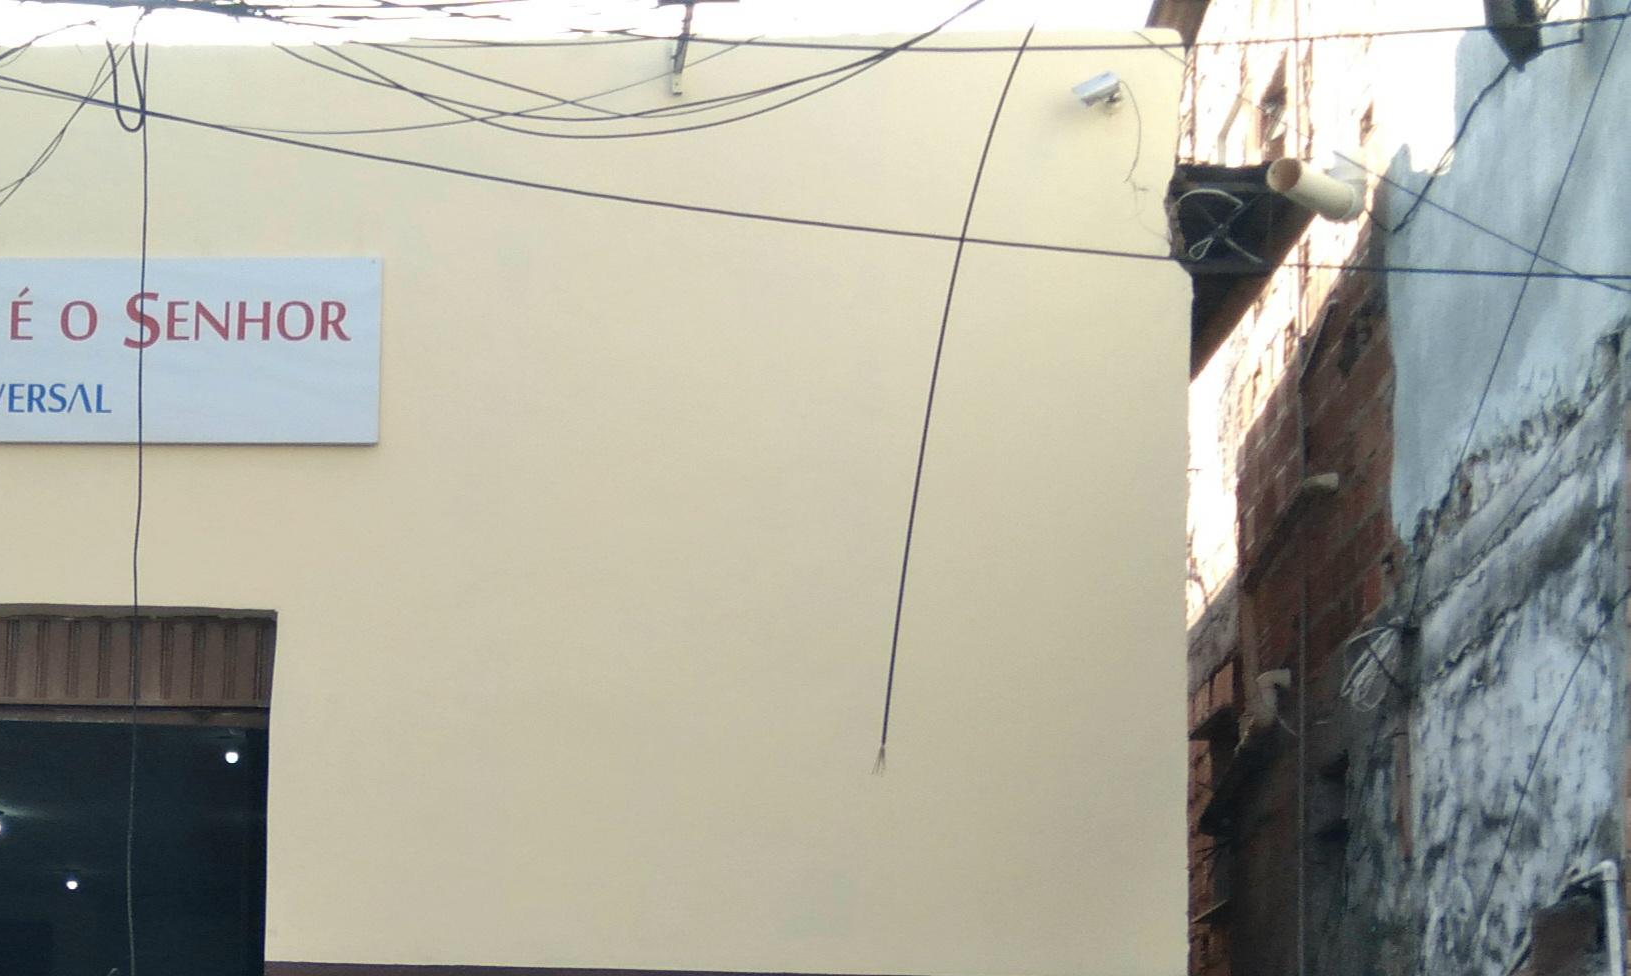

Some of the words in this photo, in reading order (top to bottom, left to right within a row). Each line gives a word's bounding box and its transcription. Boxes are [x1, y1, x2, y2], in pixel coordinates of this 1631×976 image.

[10, 286, 34, 341] É
[60, 300, 98, 341] O
[123, 292, 351, 349] SENHOR
